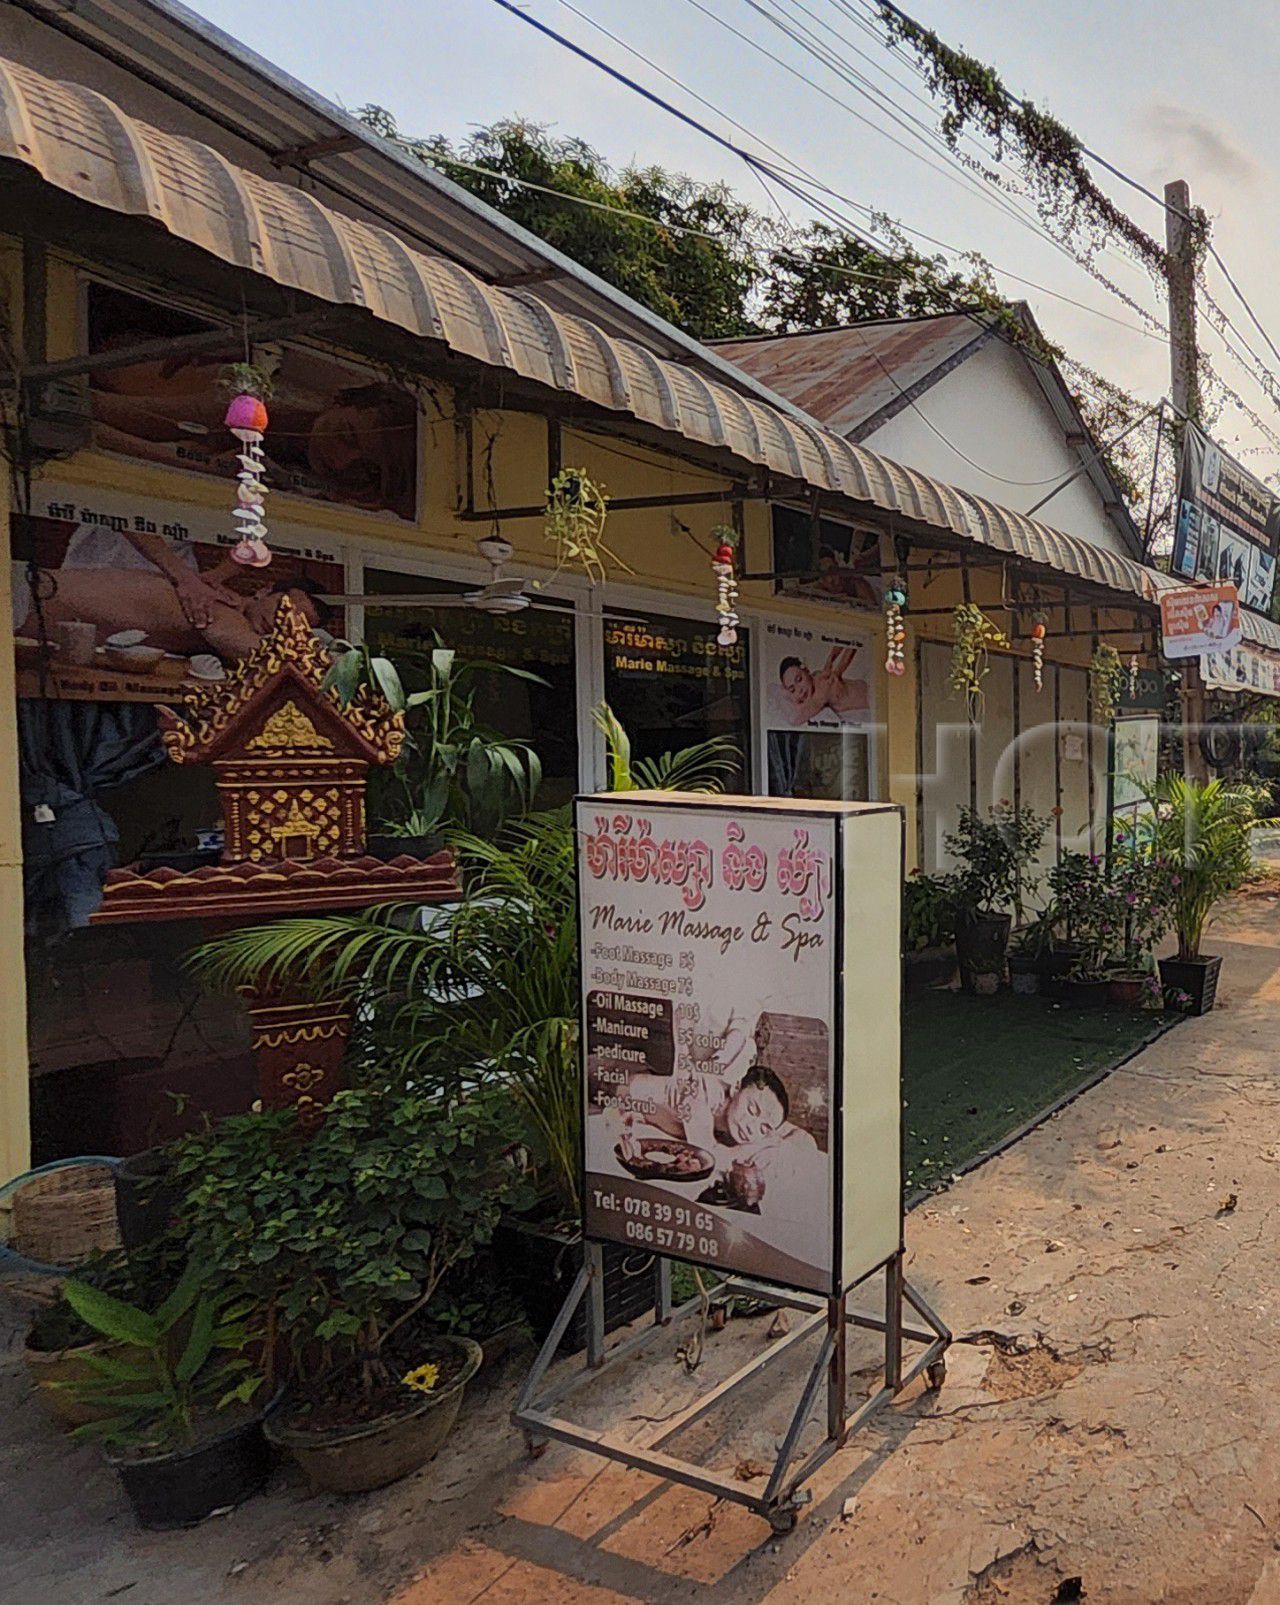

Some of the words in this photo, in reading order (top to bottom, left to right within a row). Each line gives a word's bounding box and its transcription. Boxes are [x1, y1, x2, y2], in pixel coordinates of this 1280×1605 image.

[615, 655, 653, 671] Marie
[656, 660, 710, 678] Massage
[725, 668, 746, 681] Spa
[721, 821, 767, 892] និង
[590, 904, 652, 934] Marie
[658, 910, 744, 955] Massage
[751, 911, 772, 943] &
[780, 912, 824, 962] Spa
[623, 946, 673, 969] Massage
[679, 950, 695, 972] 5$
[626, 970, 676, 995] Massage
[677, 976, 694, 996] 7$
[592, 992, 613, 1010] -Oil
[614, 995, 664, 1019] Massage
[592, 1016, 649, 1039] -Manicure
[695, 1029, 726, 1050] color
[593, 1043, 647, 1063] -pedicure
[695, 1055, 725, 1075] color
[594, 1066, 629, 1085] -Facial
[624, 1095, 657, 1115] Scrub
[594, 1190, 620, 1212] Tel:
[624, 1197, 650, 1218] 078
[654, 1203, 672, 1222] 39
[675, 1208, 691, 1227] 91
[695, 1212, 713, 1231] 65
[626, 1221, 653, 1242] 086
[656, 1227, 673, 1246] 57
[677, 1232, 695, 1251] 79
[699, 1237, 718, 1257] 08
